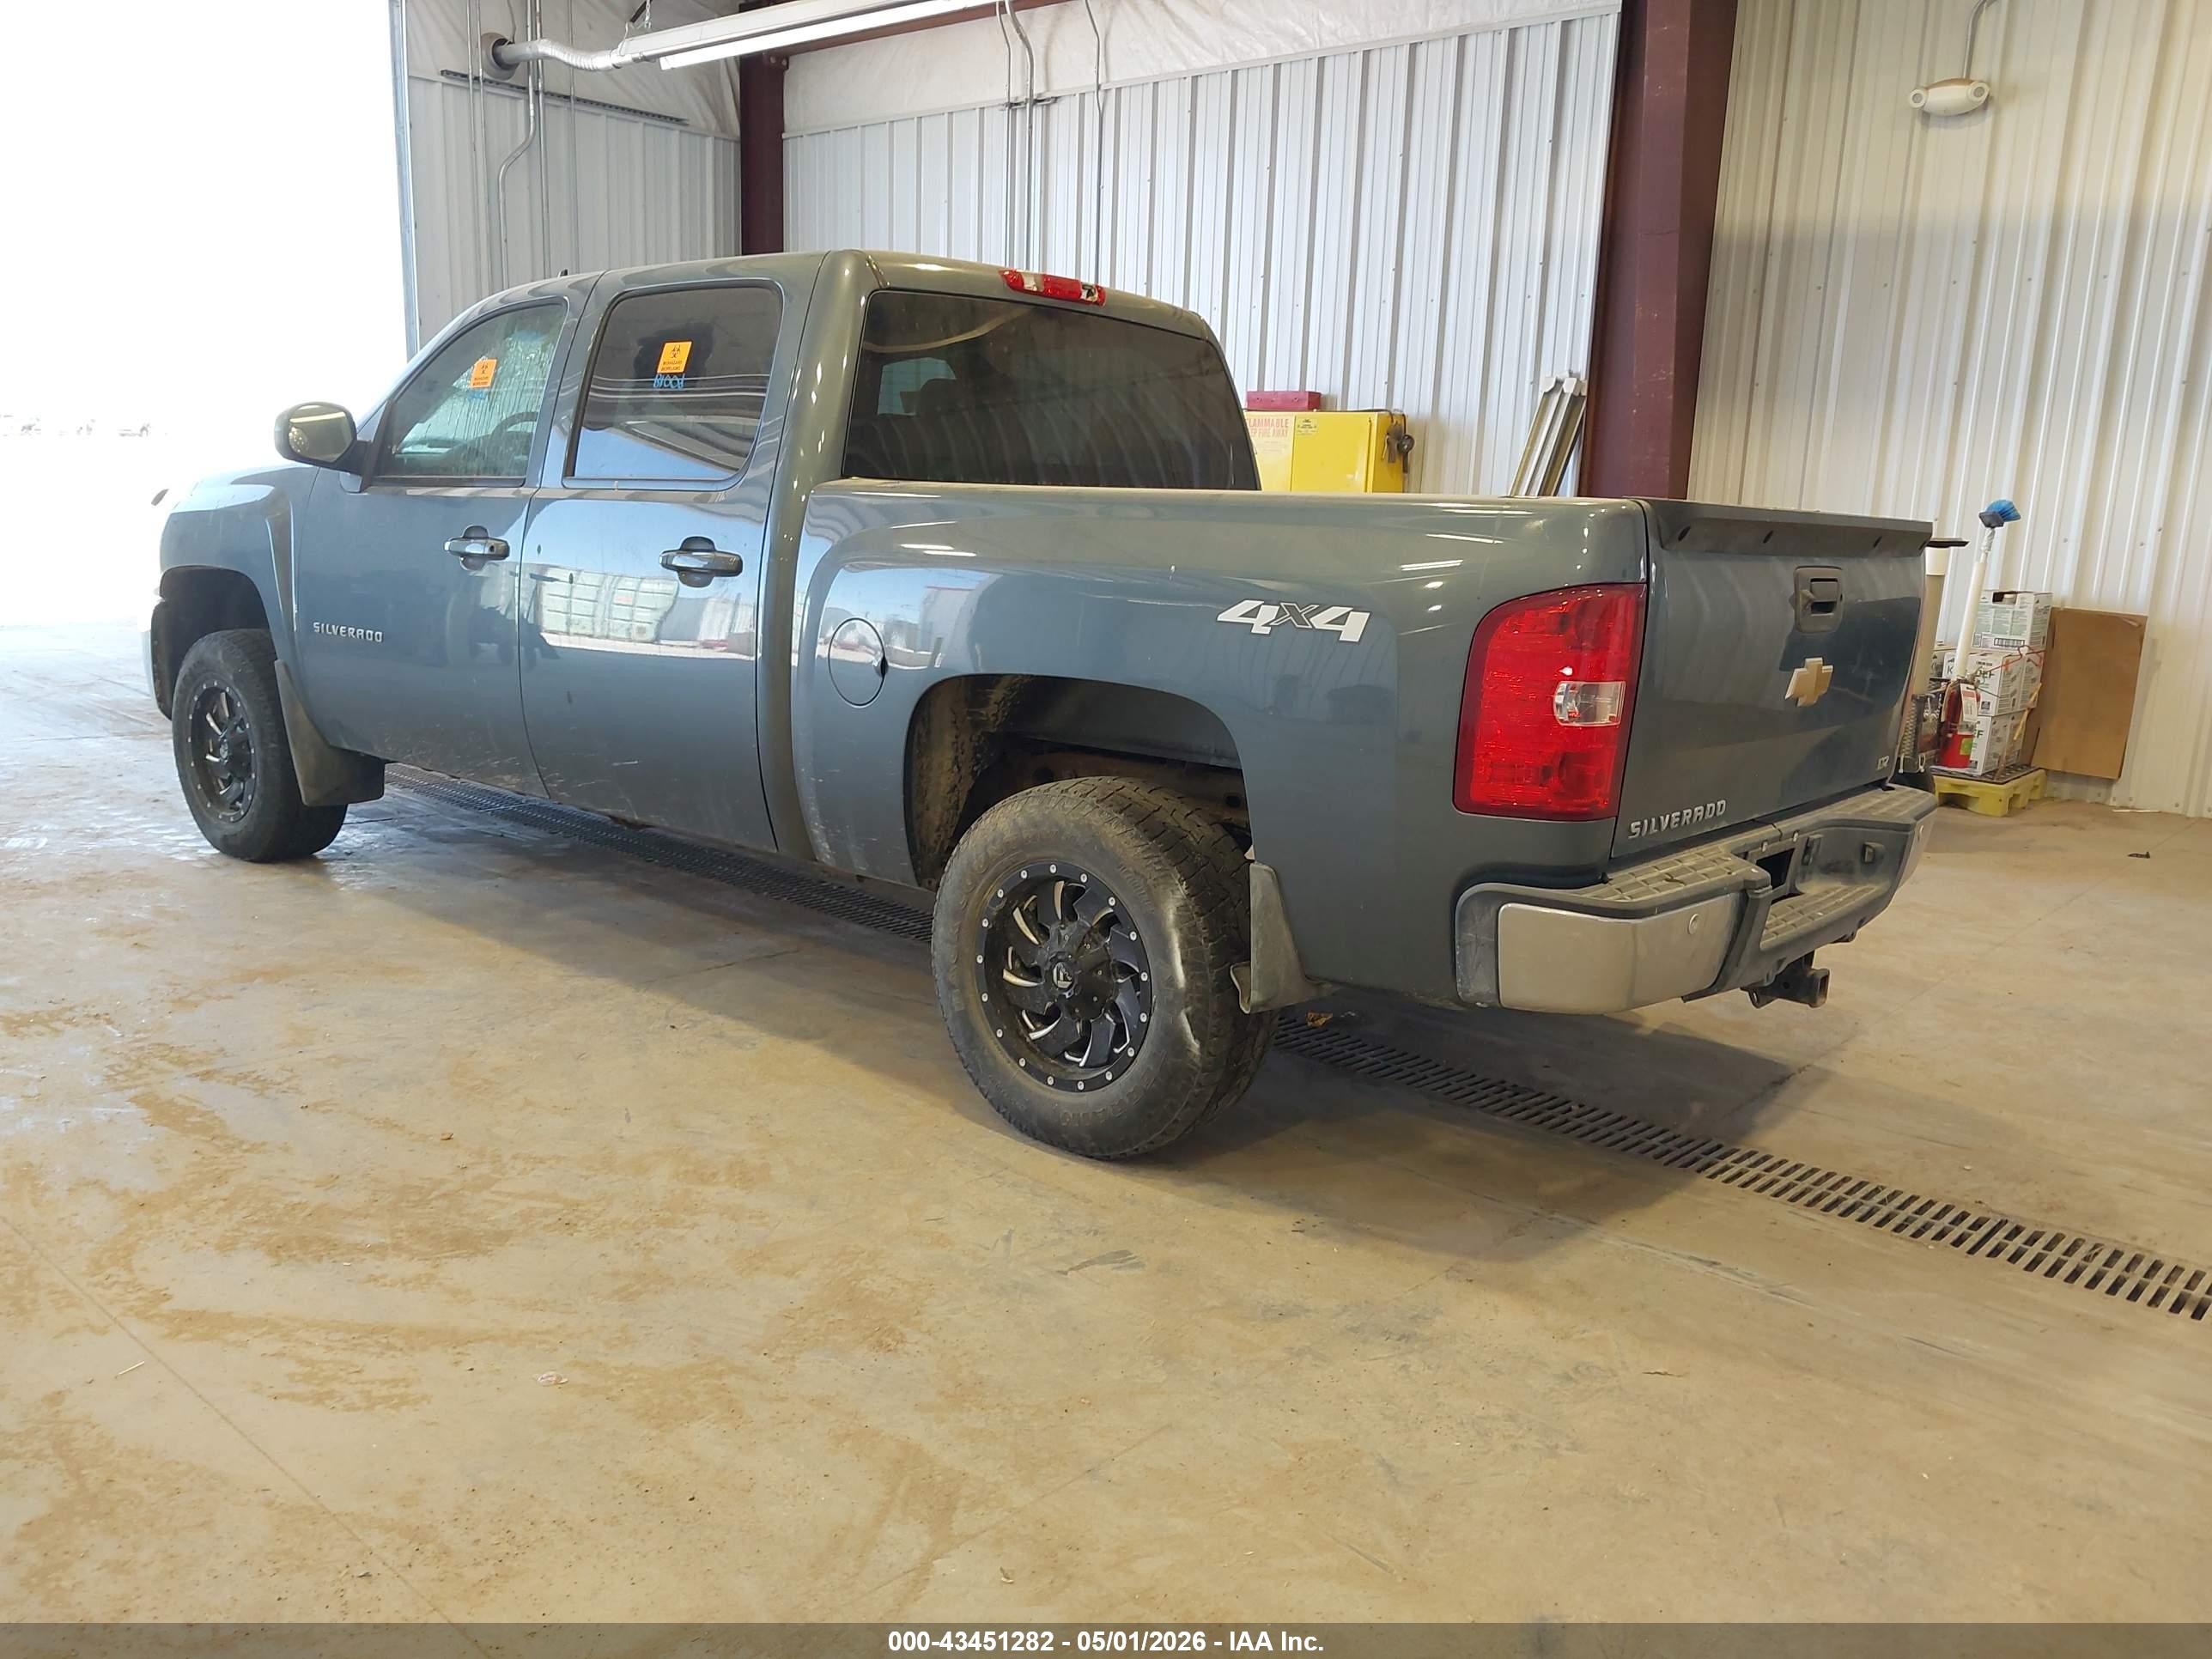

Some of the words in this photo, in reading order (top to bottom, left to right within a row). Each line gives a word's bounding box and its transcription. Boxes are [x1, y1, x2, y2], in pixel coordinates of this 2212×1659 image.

[1247, 417, 1289, 428] LAMMABLE
[313, 621, 383, 643] SILVERADO
[1628, 799, 1728, 840] SILVERADO
